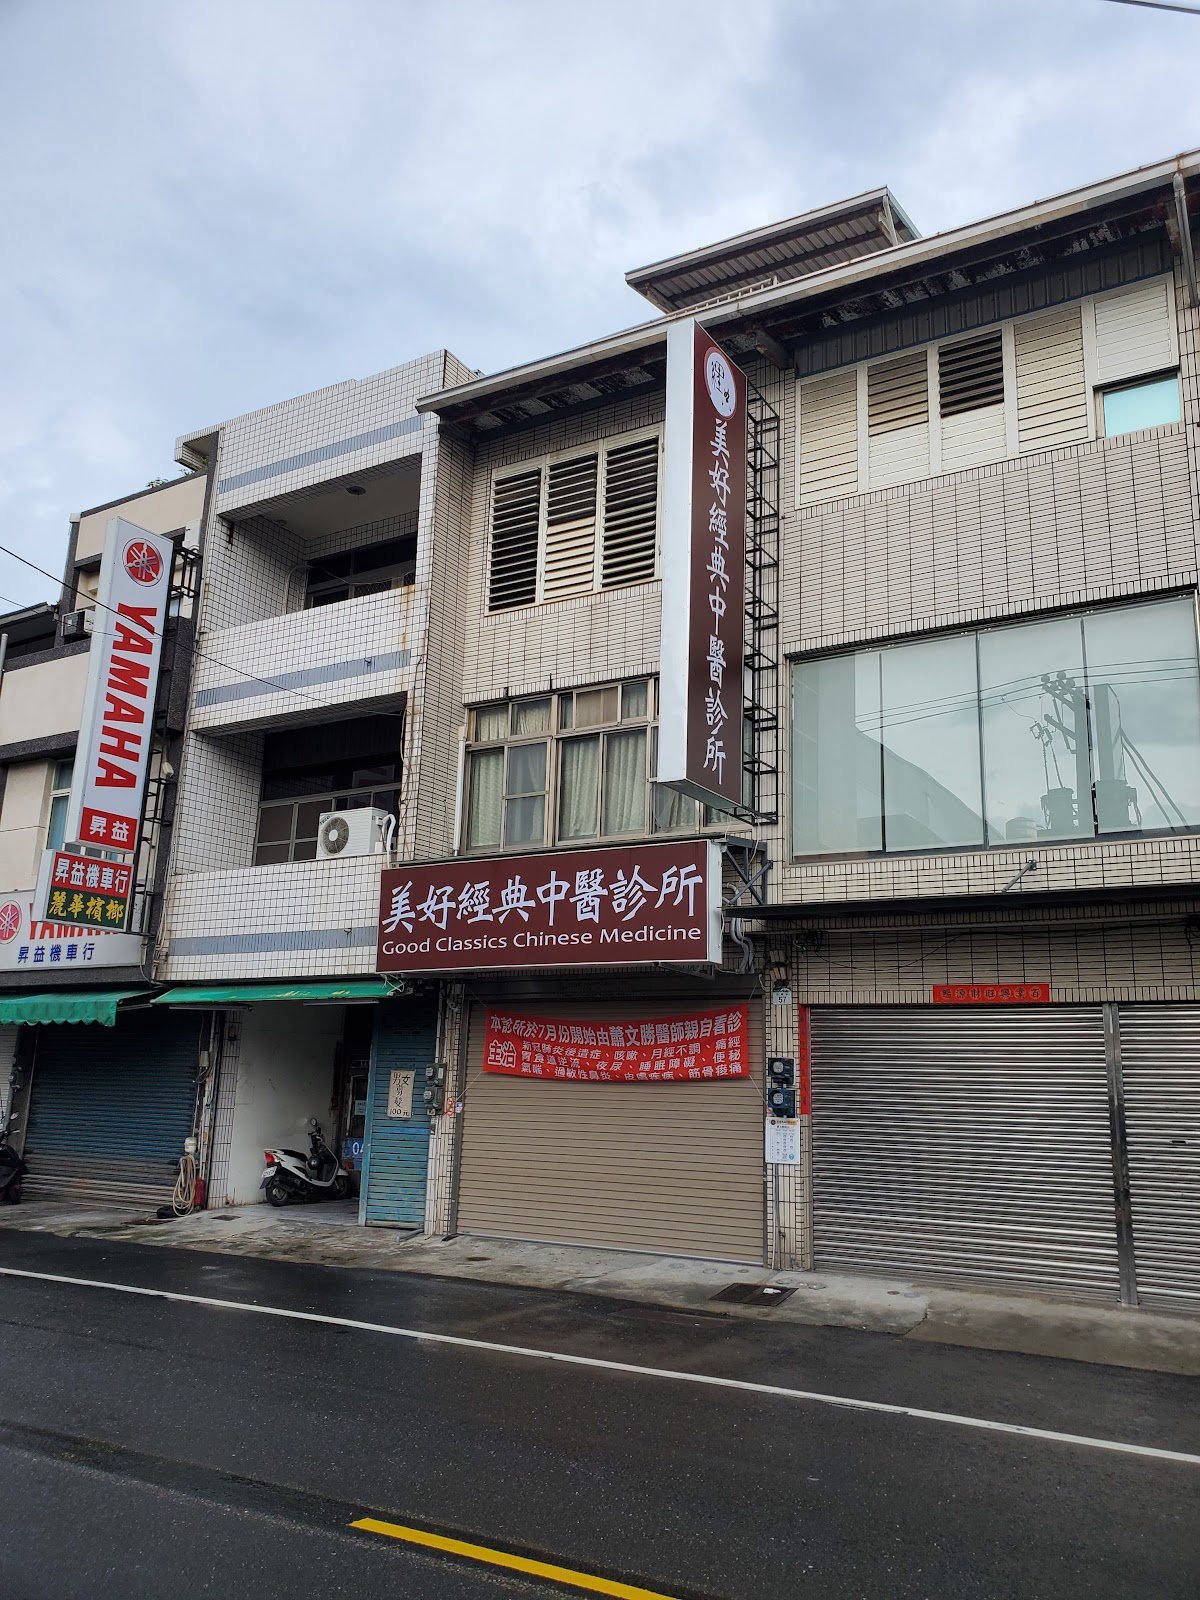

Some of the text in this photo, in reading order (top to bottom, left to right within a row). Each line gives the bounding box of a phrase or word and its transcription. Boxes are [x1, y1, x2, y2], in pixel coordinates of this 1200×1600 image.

[702, 419, 732, 786] 美好經典中醫診所
[94, 602, 158, 788] YAMAHA
[90, 815, 130, 843] 昇益
[54, 857, 130, 894] 昇益機車行
[48, 890, 126, 925] 麗華檳榔
[381, 863, 704, 935] 美好經典中醫診所
[17, 942, 96, 964] 昇益機車行
[382, 925, 702, 956] Good Classics Chinese Medicine
[778, 996, 787, 1004] 57
[490, 1010, 743, 1047] 本診所於7月份開始由蕭文勝醫師親自看診
[487, 1039, 518, 1069] 主治
